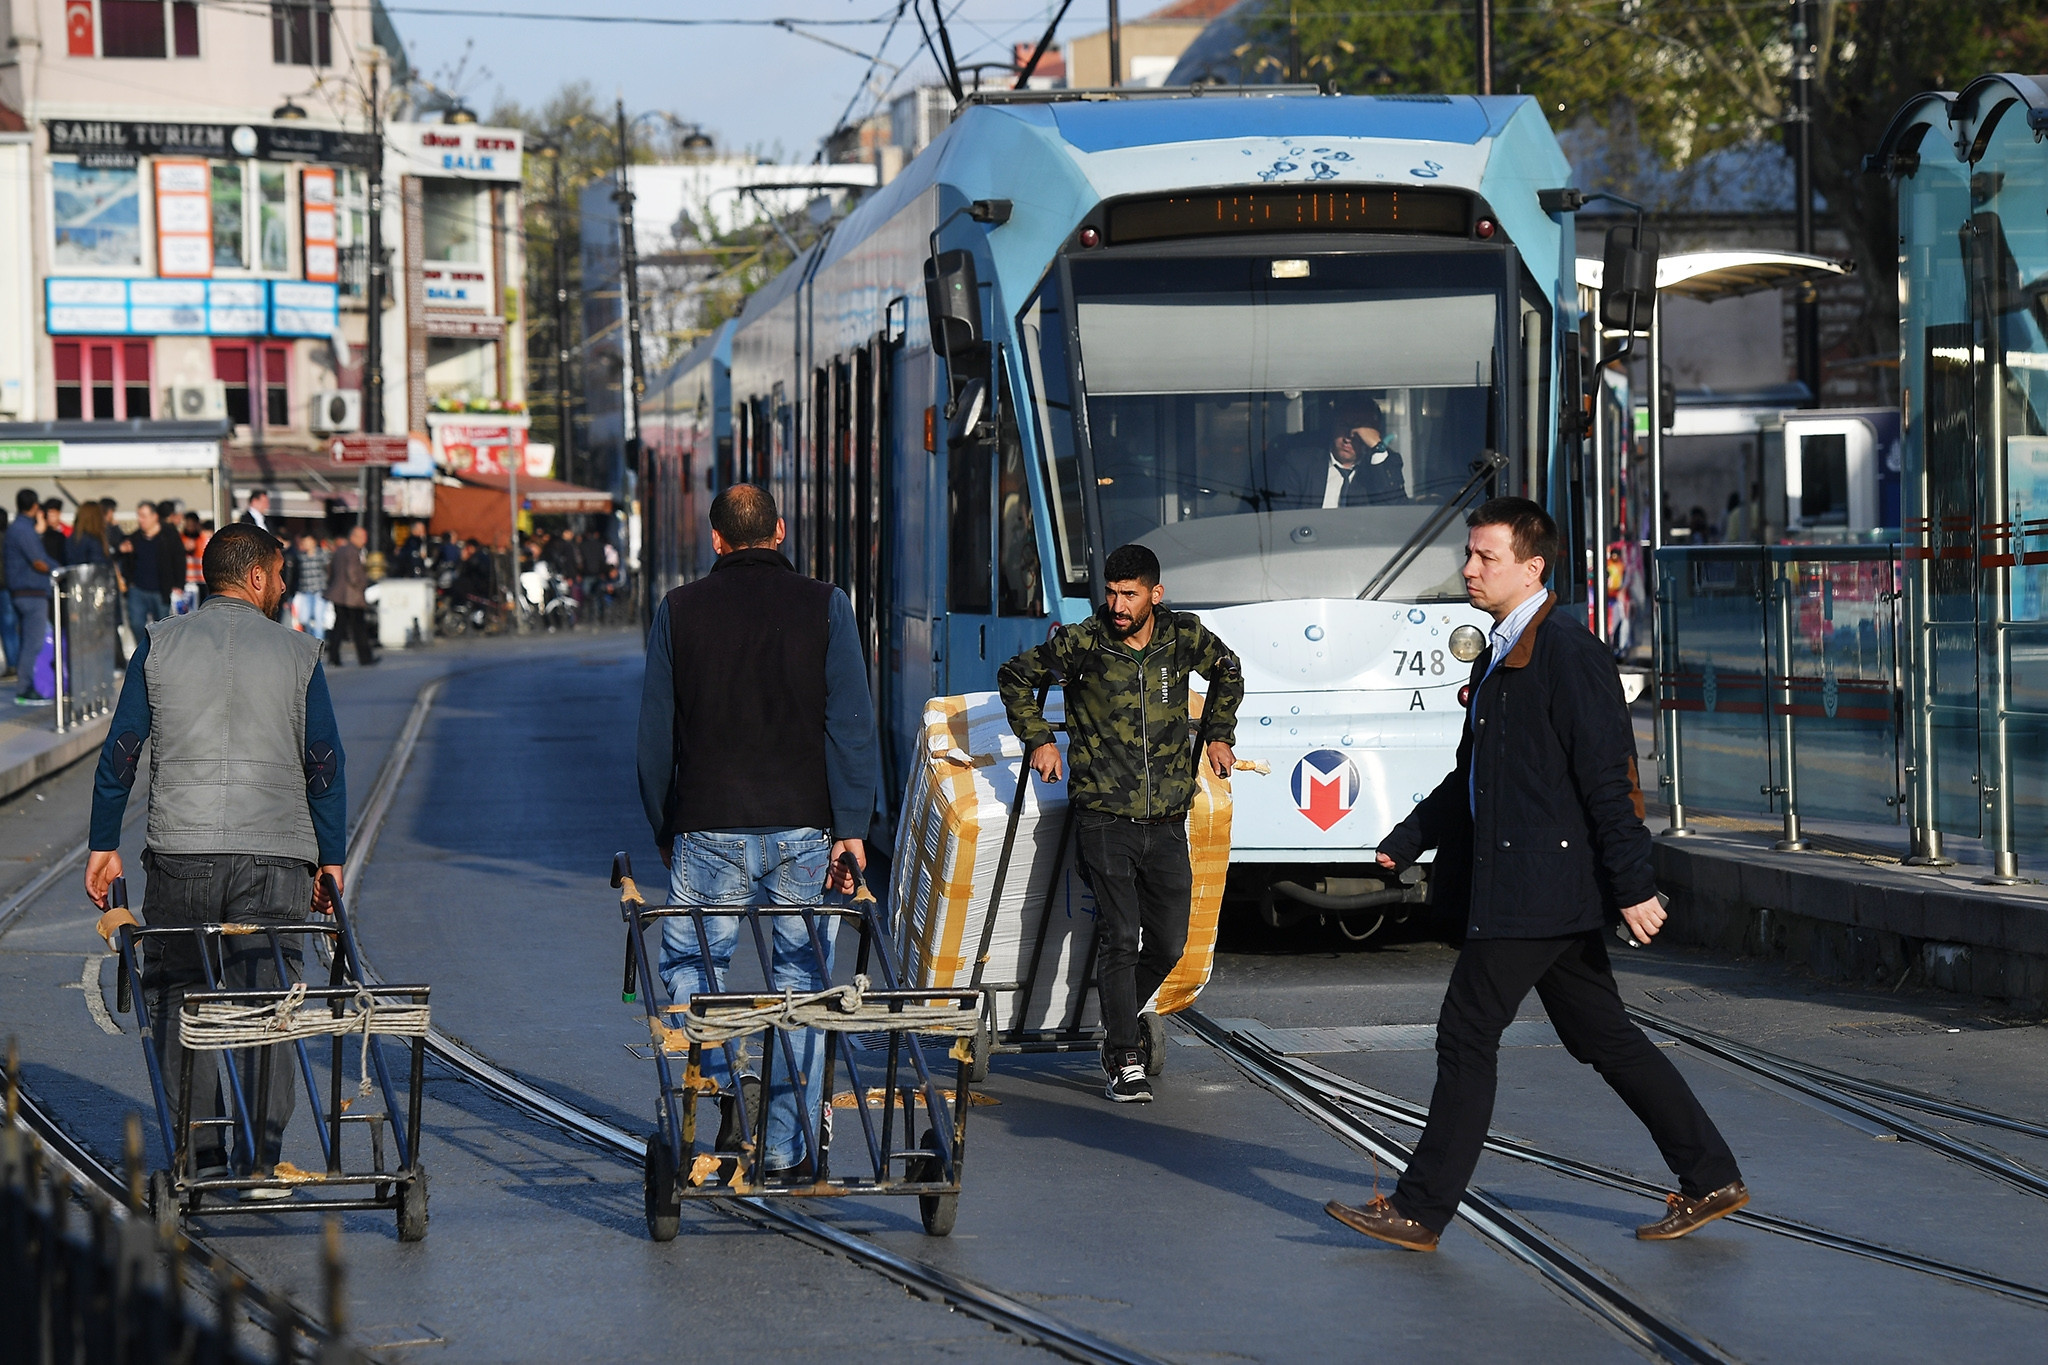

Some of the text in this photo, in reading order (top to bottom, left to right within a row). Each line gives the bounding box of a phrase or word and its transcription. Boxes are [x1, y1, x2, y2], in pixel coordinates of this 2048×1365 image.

[53, 120, 127, 146] SAHİL
[1393, 649, 1446, 677] 748
[1161, 681, 1169, 703] PEOPLE
[1409, 690, 1426, 711] A
[1300, 757, 1350, 811] M
